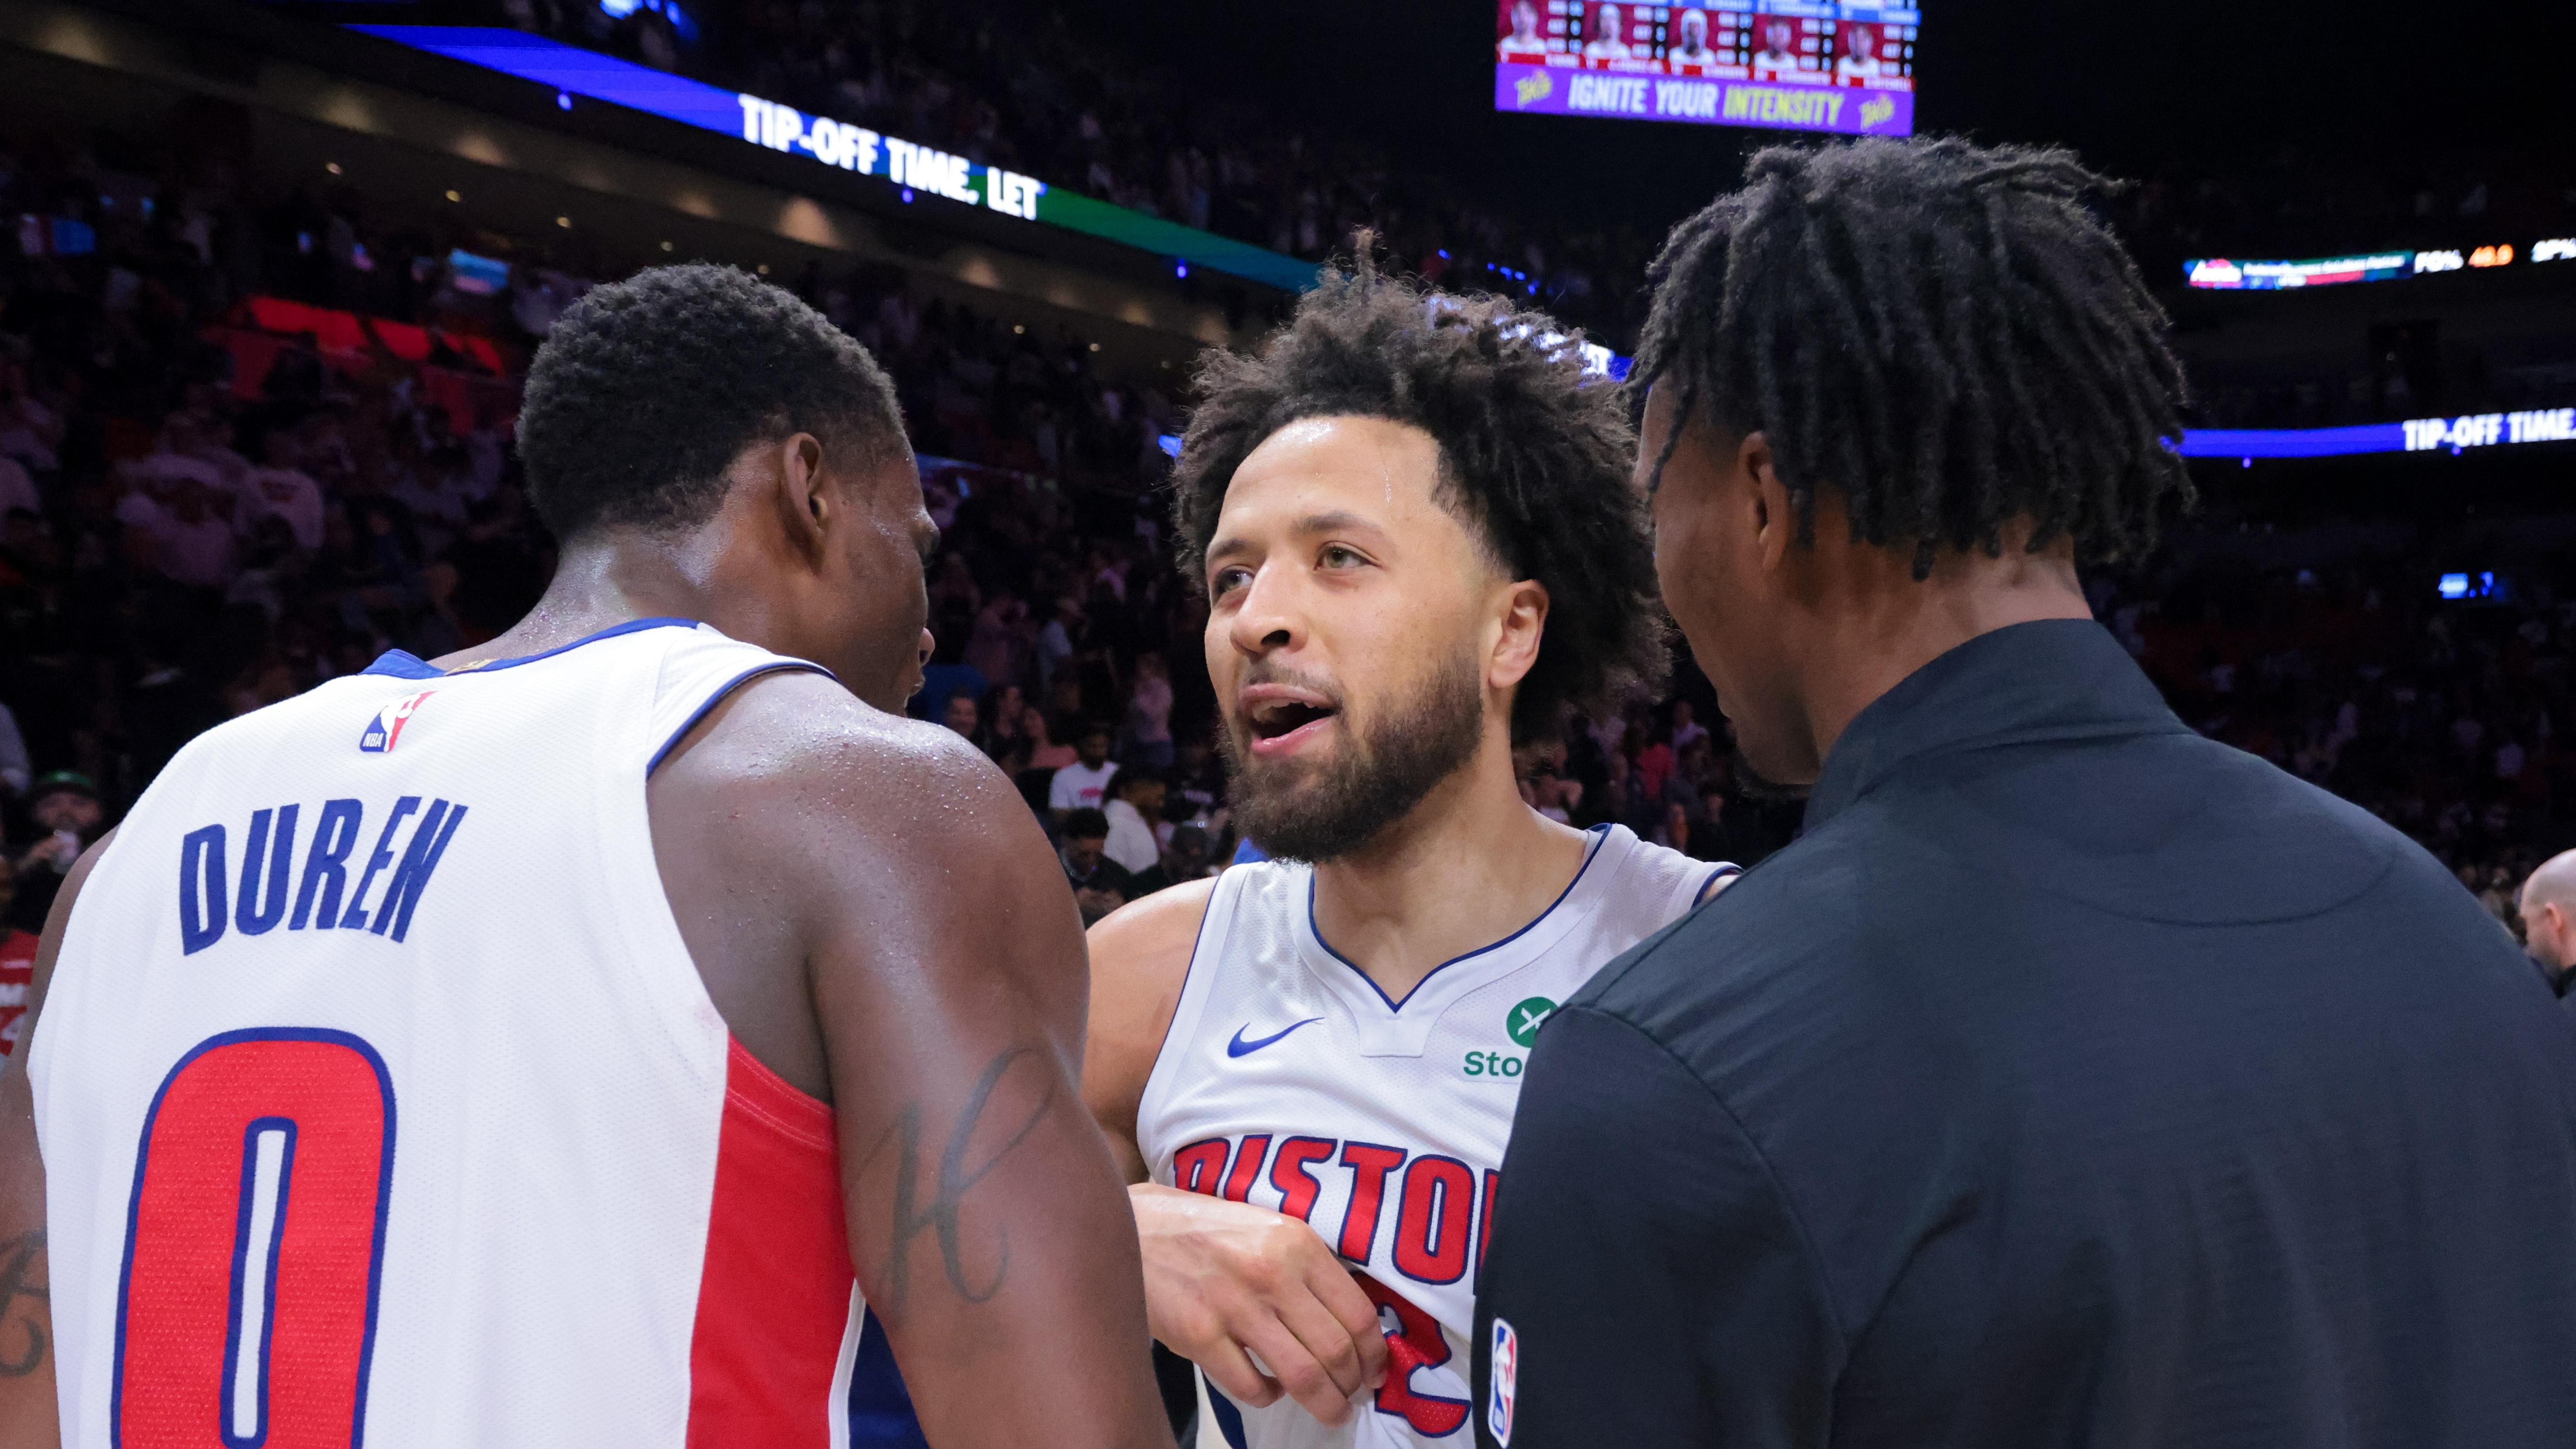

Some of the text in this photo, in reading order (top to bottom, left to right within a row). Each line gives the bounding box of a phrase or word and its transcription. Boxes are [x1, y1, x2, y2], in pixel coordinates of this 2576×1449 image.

[1568, 74, 1650, 113] IGNITE
[1655, 79, 1719, 118] YOUR
[1723, 85, 1845, 126] INTENSITY
[738, 93, 880, 175] TIP-OFF
[987, 166, 1041, 221] LET
[2402, 413, 2504, 451] TIP-OFF
[363, 733, 384, 747] NBA
[179, 796, 469, 955] DUREN
[1463, 1051, 1523, 1077] Sto
[110, 1026, 397, 1449] 0
